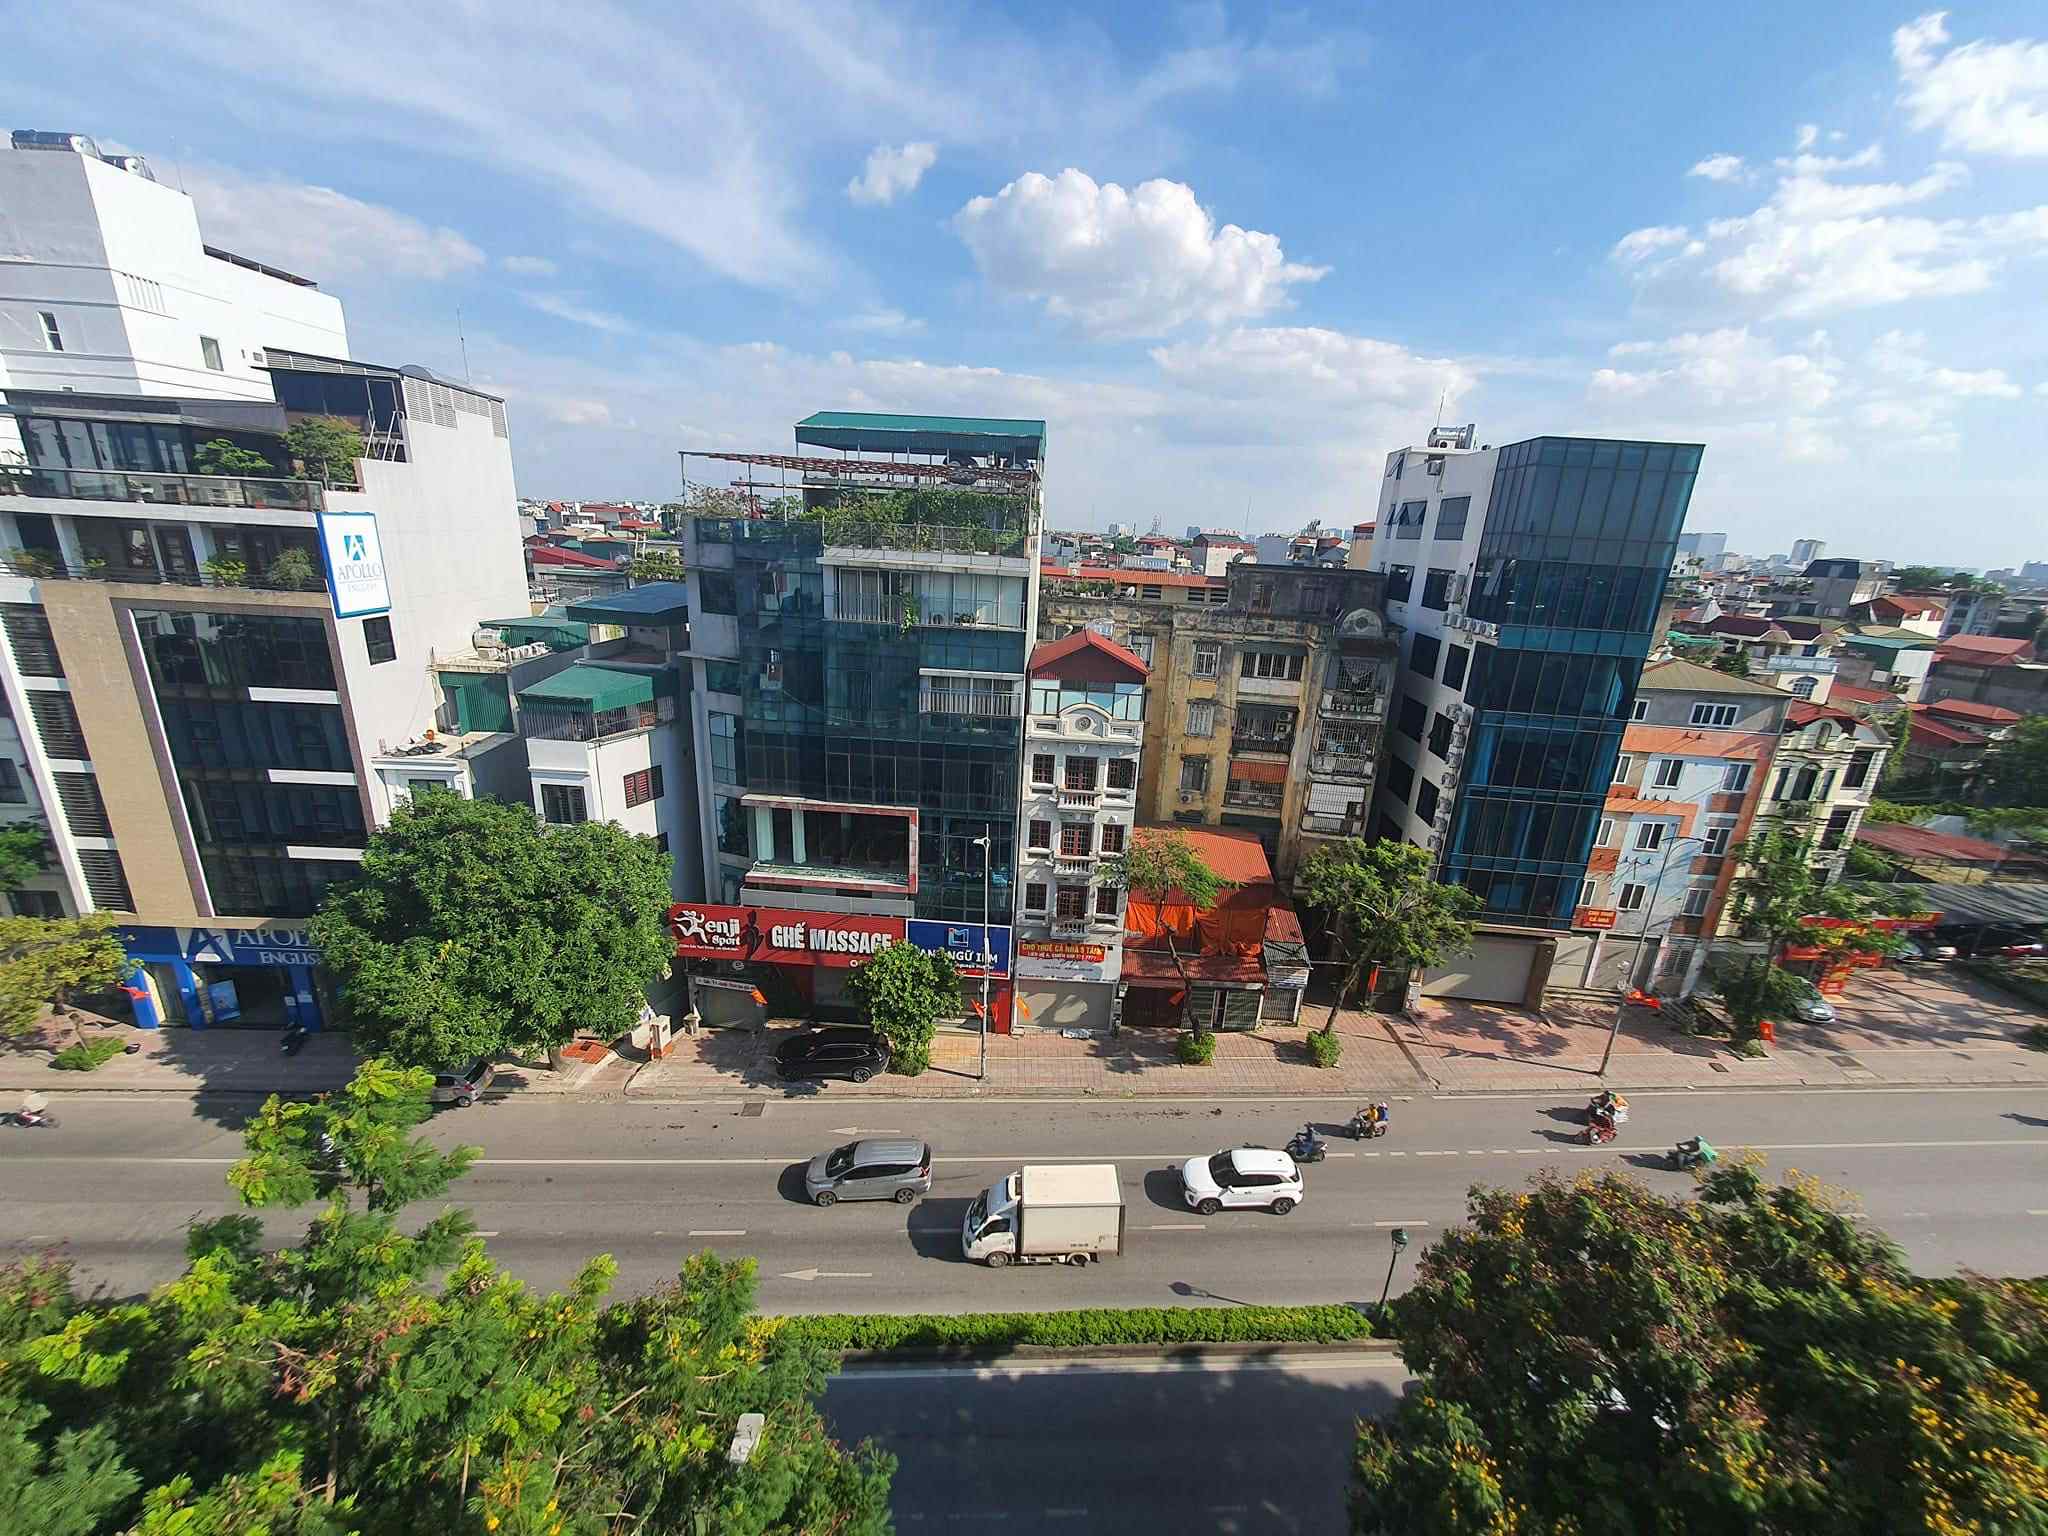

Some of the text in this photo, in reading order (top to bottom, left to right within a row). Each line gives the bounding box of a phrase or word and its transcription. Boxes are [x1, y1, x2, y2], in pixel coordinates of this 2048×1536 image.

[337, 562, 382, 580] APOLLO
[711, 934, 741, 946] Sport
[771, 921, 806, 949] GHẾ
[259, 950, 320, 965] ENGLIS
